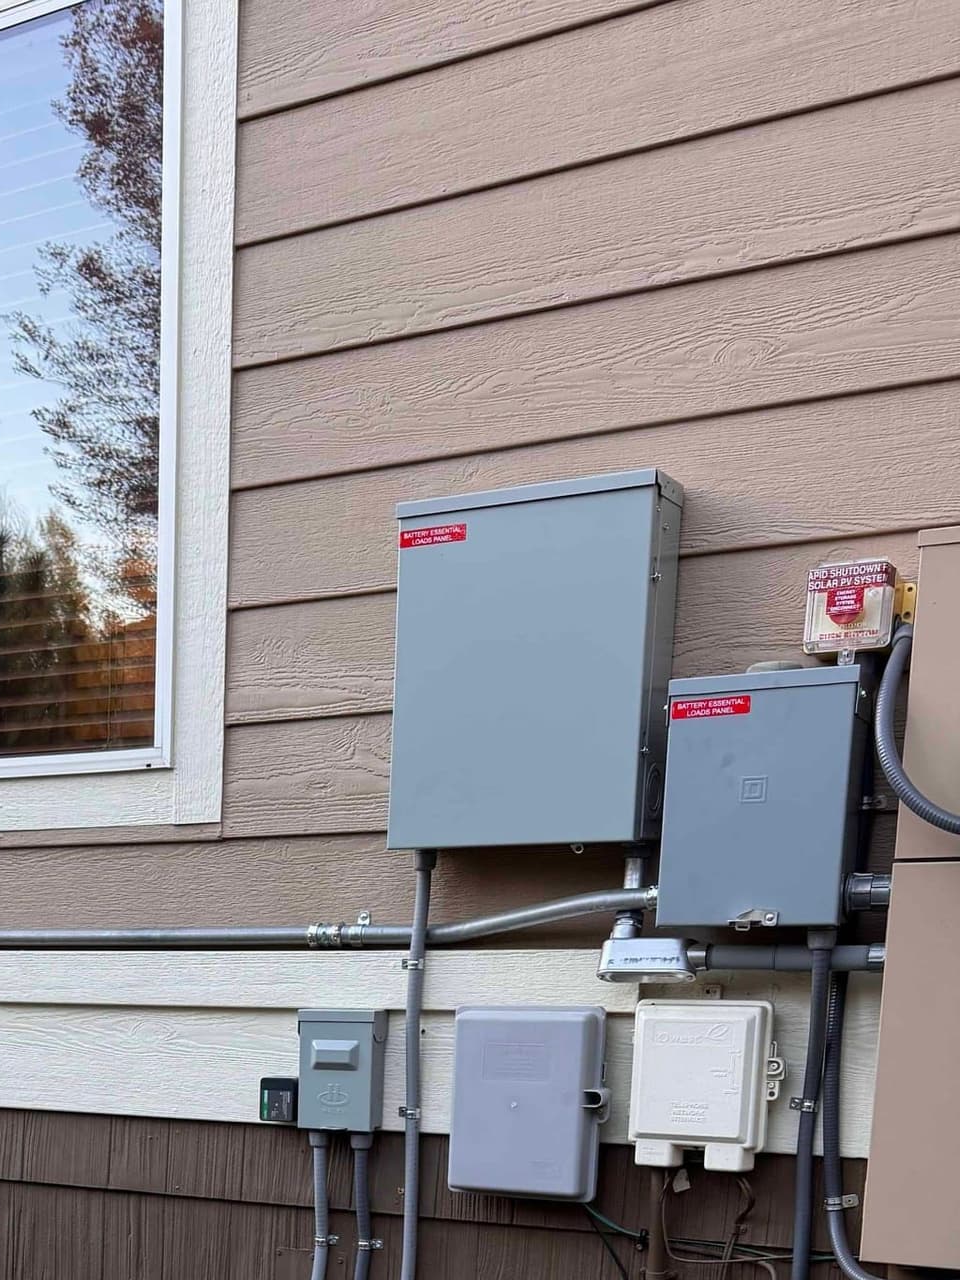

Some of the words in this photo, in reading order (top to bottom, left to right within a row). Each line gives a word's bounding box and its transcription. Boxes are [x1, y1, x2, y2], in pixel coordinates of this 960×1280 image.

[403, 530, 429, 539] BATTERY
[430, 526, 461, 536] ESSENTIAL
[411, 537, 432, 545] LOADS
[433, 534, 453, 543] PANEL
[808, 570, 827, 581] APID
[829, 565, 880, 578] SHUTDOWN
[808, 579, 838, 591] SOLAR
[840, 577, 853, 586] PV
[677, 701, 707, 710] BATTERY
[708, 698, 745, 707] ESSENTIAL
[686, 709, 711, 717] LOADS
[712, 707, 735, 715] PANEL
